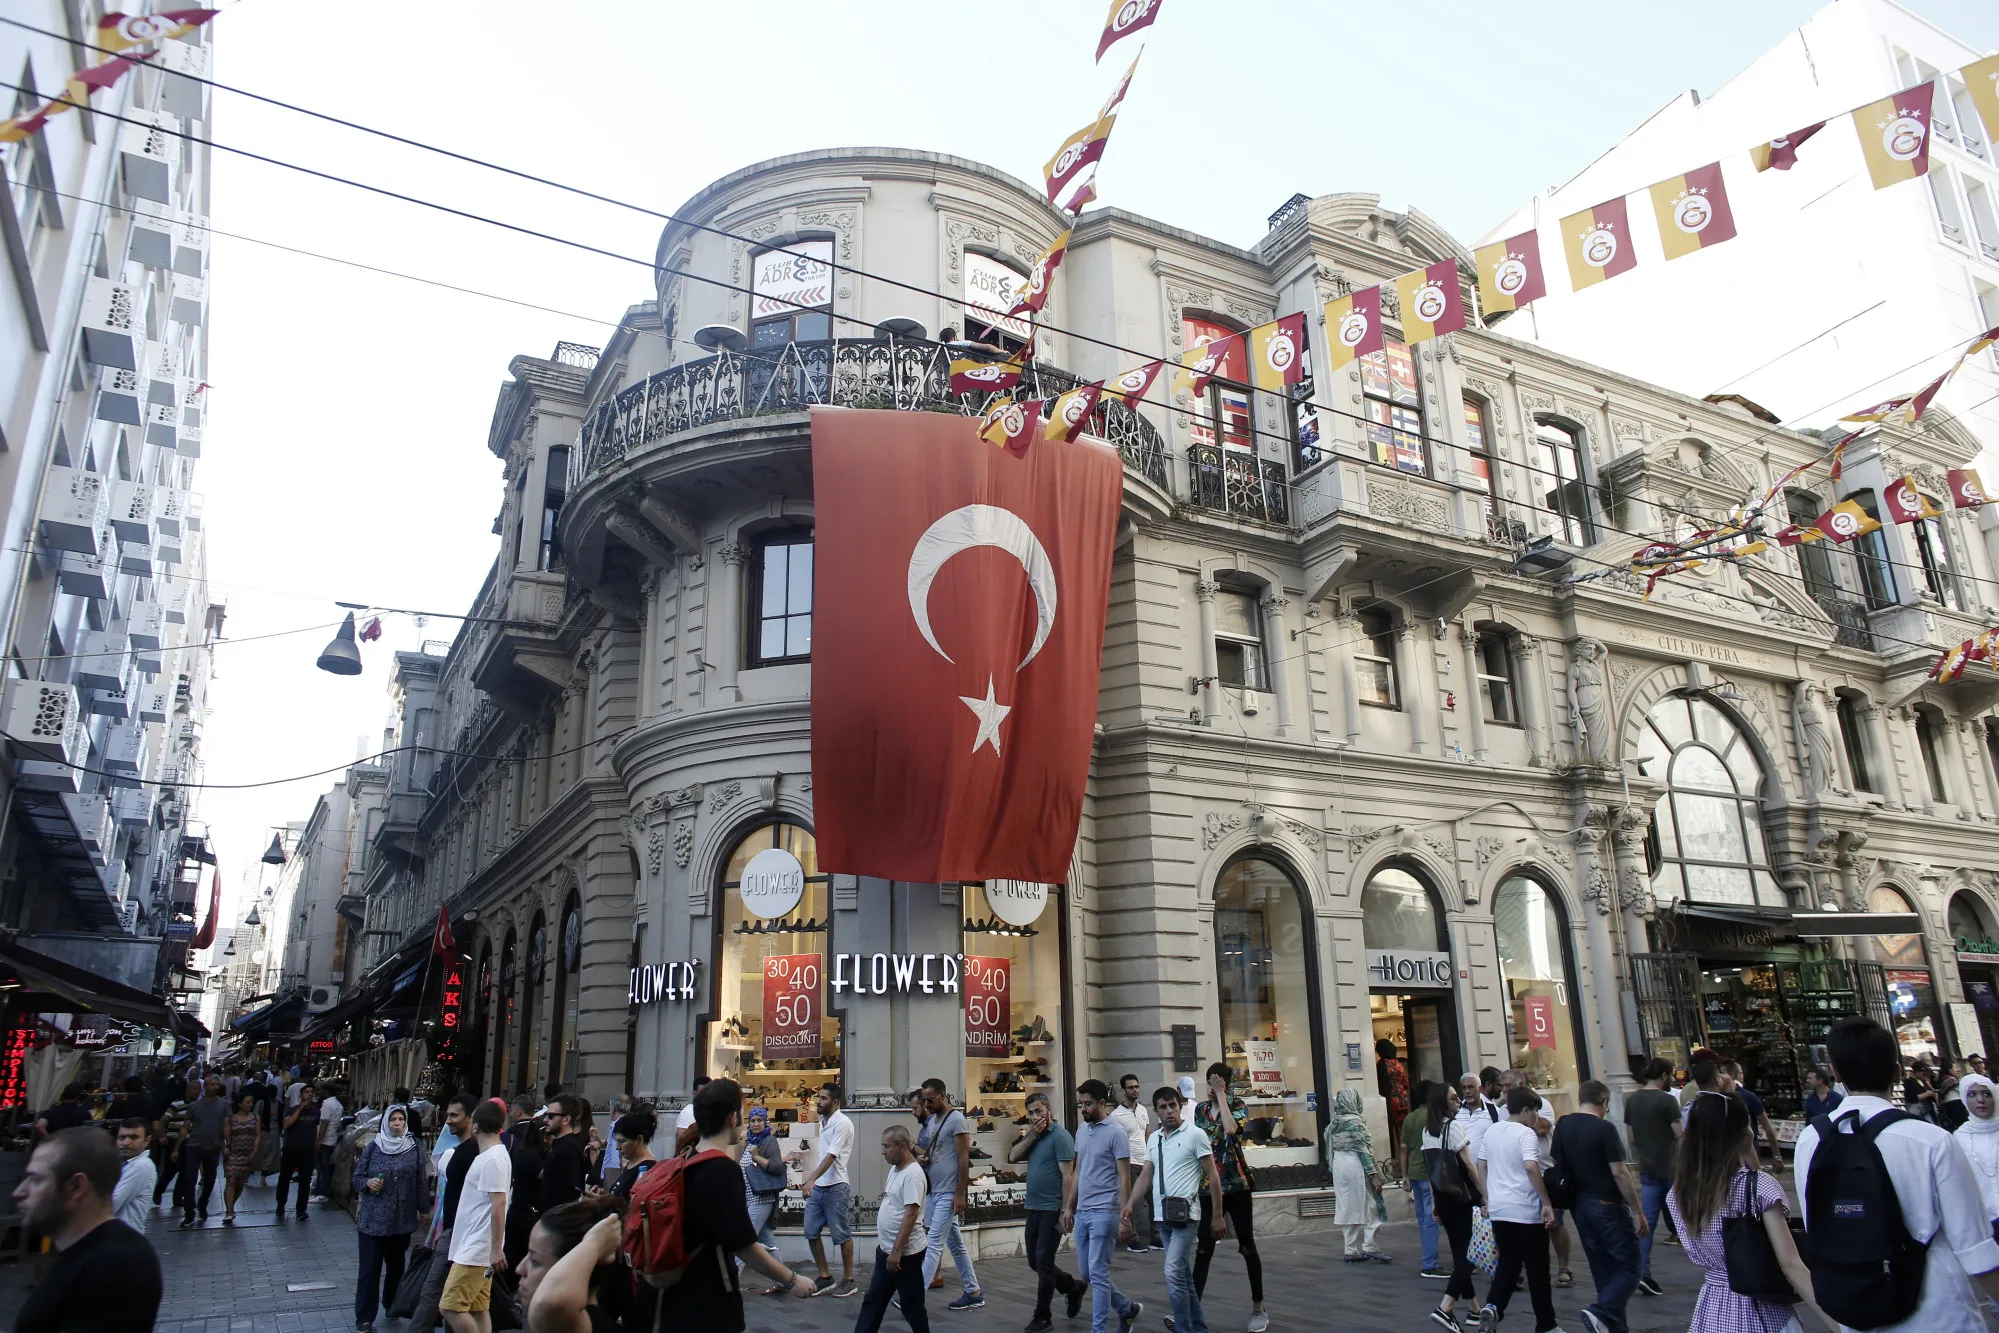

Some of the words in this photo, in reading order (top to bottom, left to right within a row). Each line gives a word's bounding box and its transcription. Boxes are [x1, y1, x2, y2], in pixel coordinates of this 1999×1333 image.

[765, 260, 793, 271] CLUB
[973, 268, 998, 282] CLUB
[1691, 641, 1707, 657] DE
[992, 879, 1041, 900] FOWER
[1533, 1007, 1546, 1032] 5
[765, 1033, 818, 1047] DISCOUNT
[966, 1029, 1007, 1046] NDİRİM
